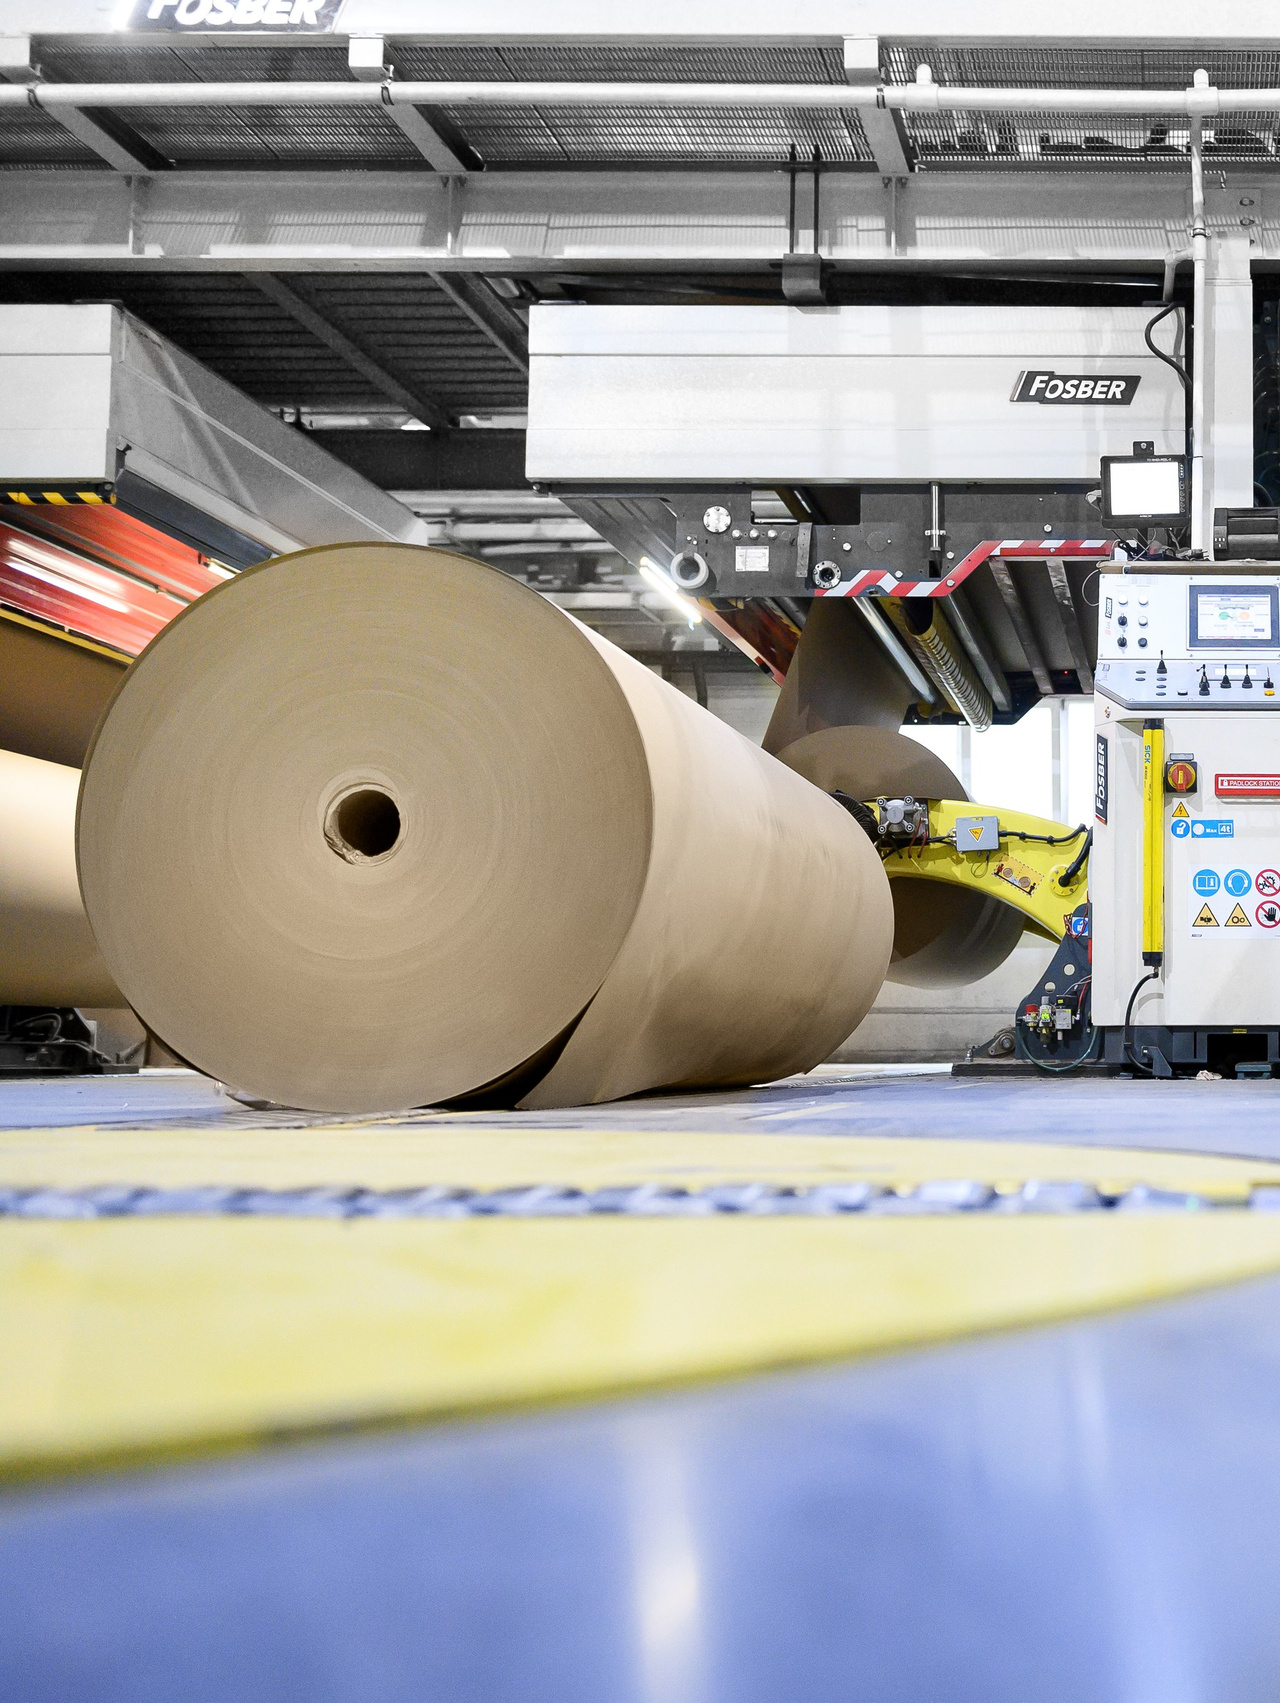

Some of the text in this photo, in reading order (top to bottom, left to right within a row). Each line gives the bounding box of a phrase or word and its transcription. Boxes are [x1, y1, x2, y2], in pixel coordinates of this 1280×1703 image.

[146, 0, 324, 25] FOSBER
[1028, 375, 1126, 399] FOSBER
[1096, 742, 1105, 810] FOSBER
[1220, 825, 1231, 833] 4t
